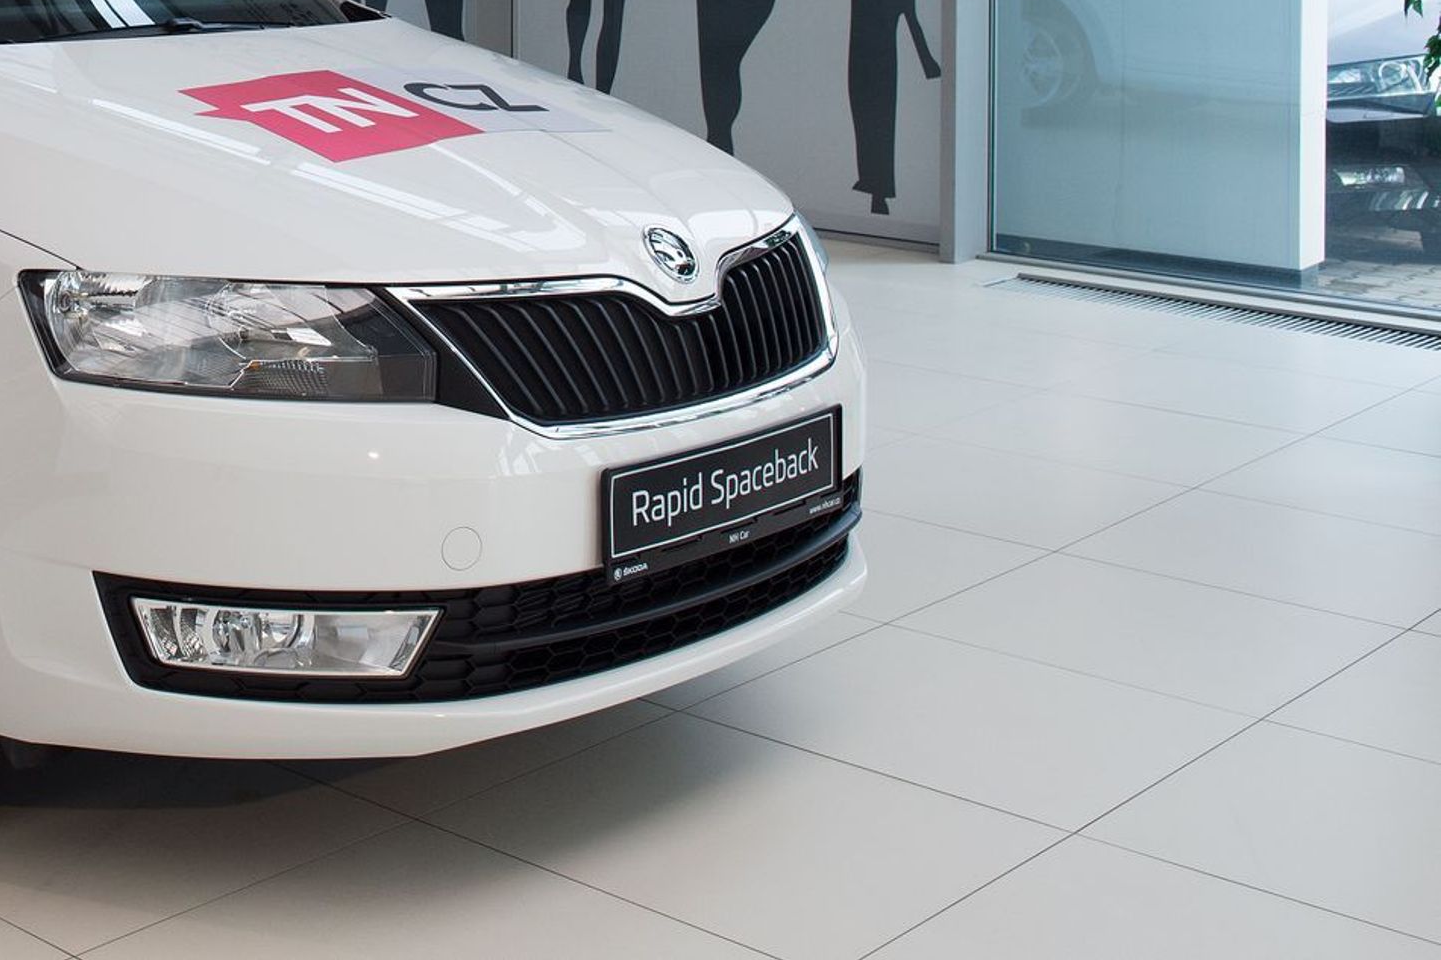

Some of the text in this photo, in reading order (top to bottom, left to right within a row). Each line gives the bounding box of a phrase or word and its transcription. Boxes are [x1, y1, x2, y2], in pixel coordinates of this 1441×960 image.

[240, 82, 550, 134] TN CZ
[632, 438, 819, 527] Rapid Spaceback
